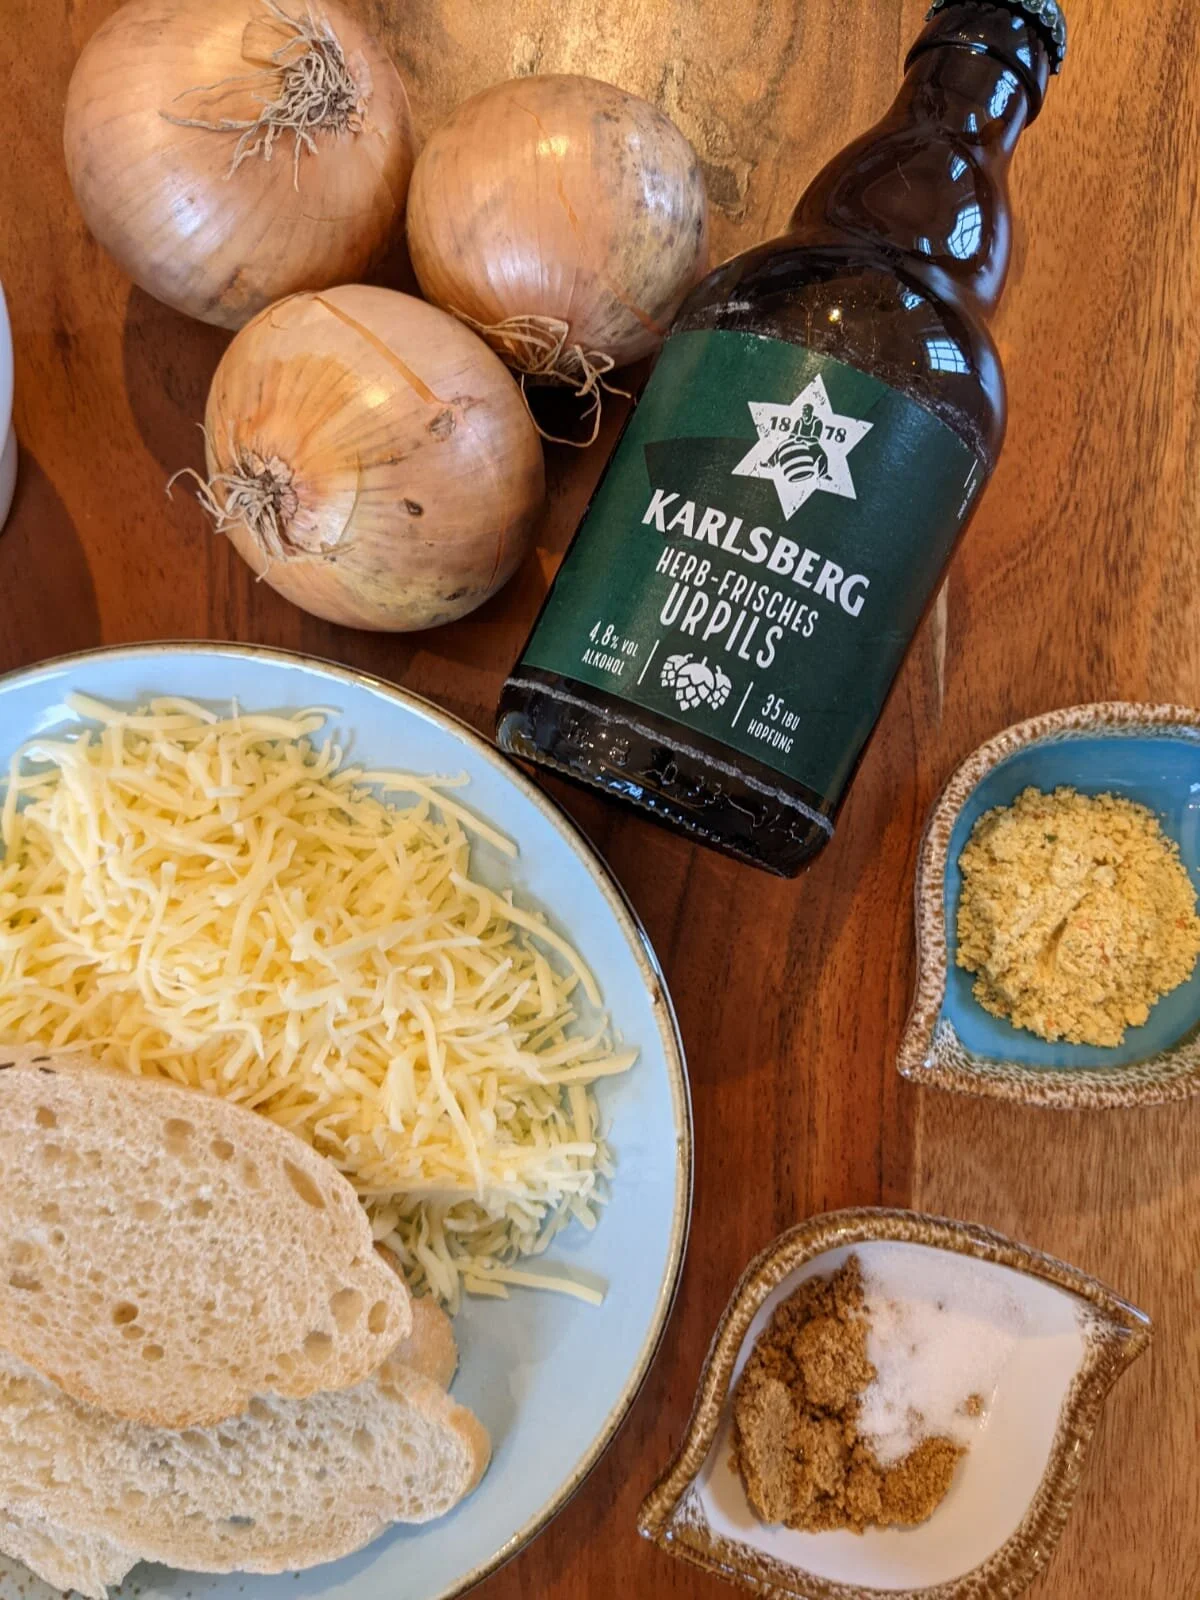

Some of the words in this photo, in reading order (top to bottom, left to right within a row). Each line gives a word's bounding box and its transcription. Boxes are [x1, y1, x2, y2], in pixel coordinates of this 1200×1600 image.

[770, 415, 791, 432] 18
[825, 425, 847, 443] 78
[642, 489, 870, 617] KARLSBERG
[655, 546, 819, 638] HERB-FRISCHES
[660, 582, 783, 669] URPILS
[581, 648, 625, 676] ALKOHOL
[621, 640, 640, 658] VOL
[761, 694, 785, 721] 35
[781, 710, 801, 732] IBU
[747, 719, 794, 754] HOPFUNG
